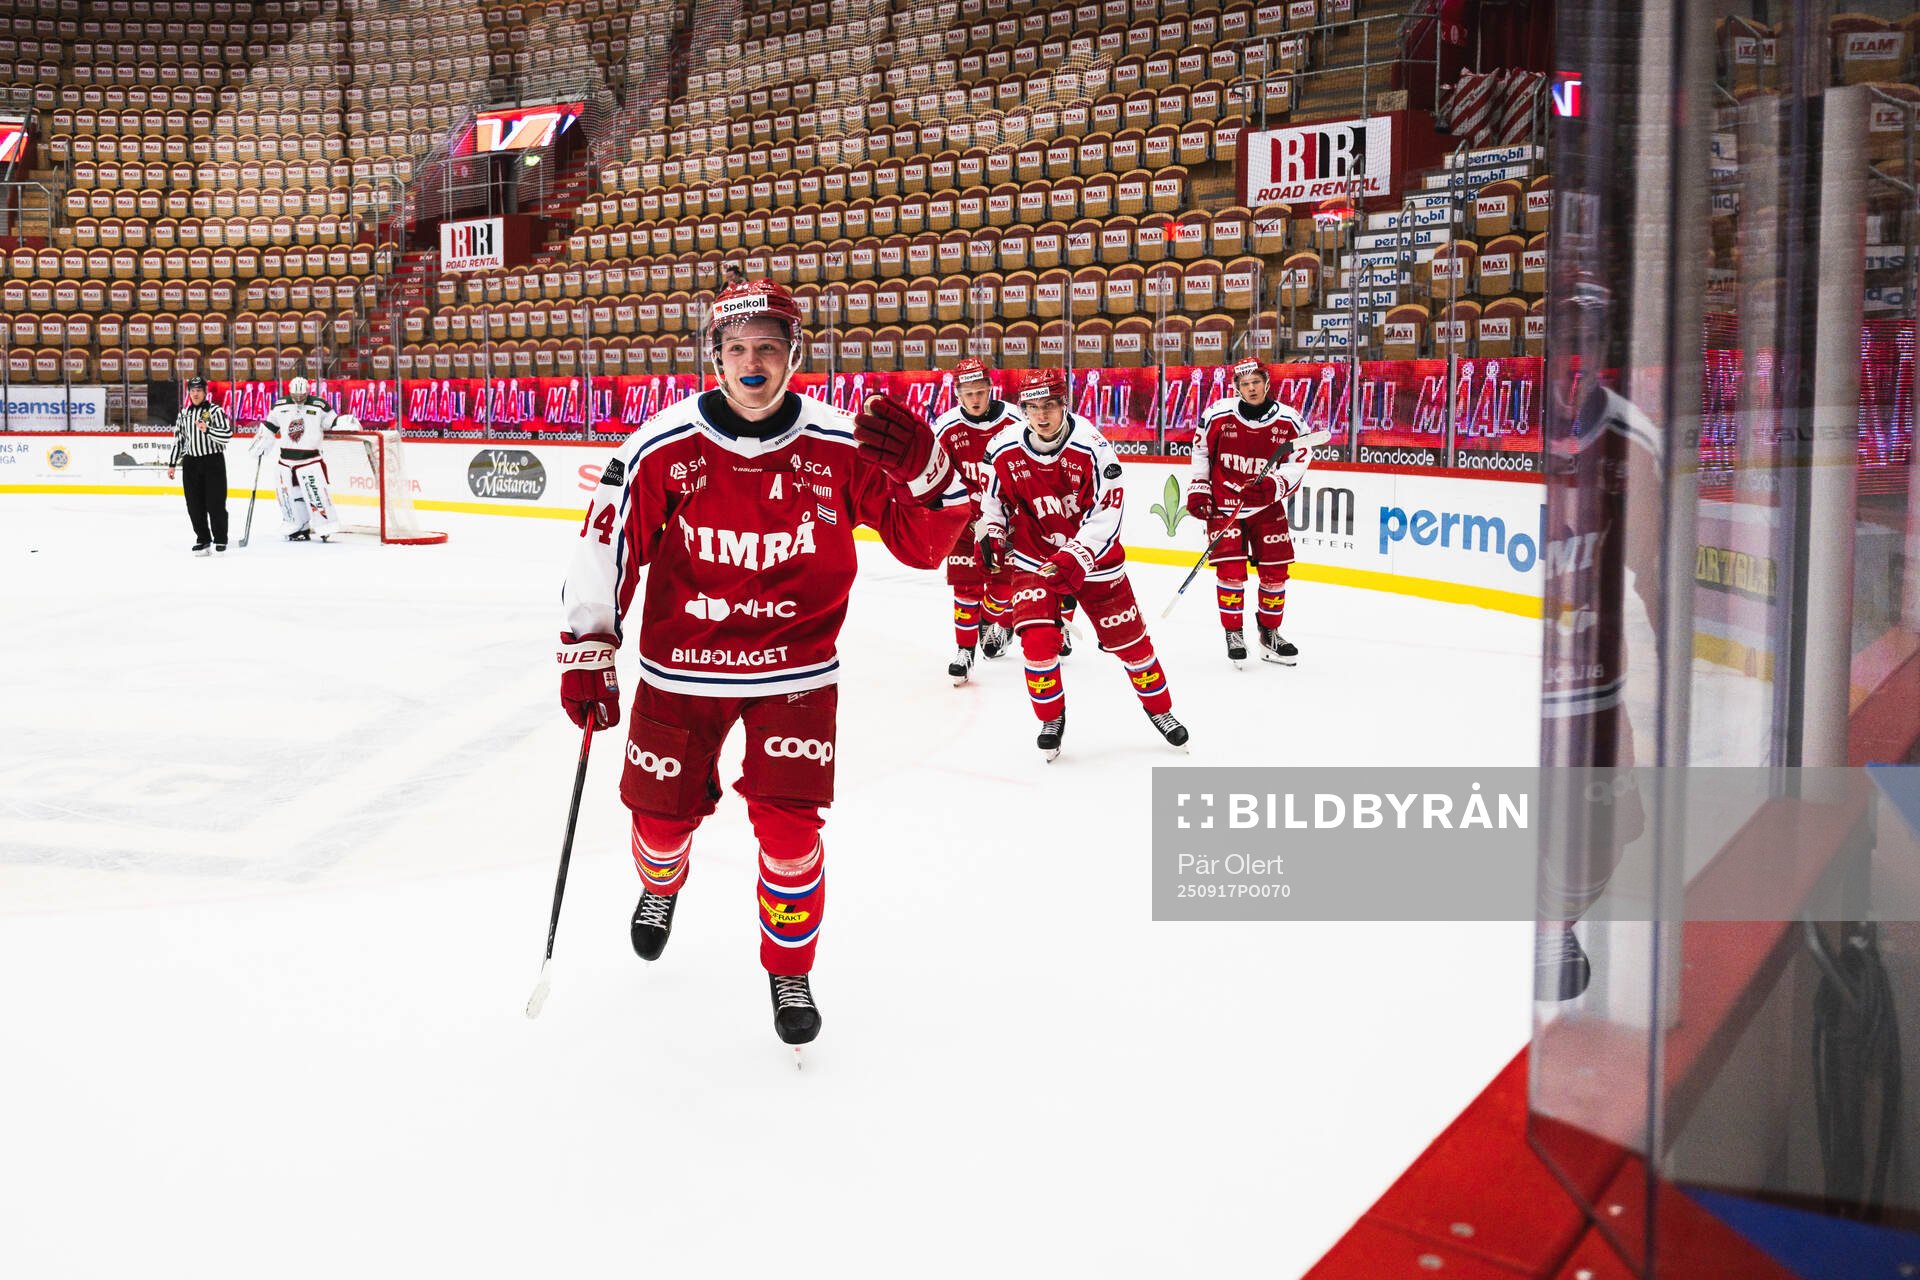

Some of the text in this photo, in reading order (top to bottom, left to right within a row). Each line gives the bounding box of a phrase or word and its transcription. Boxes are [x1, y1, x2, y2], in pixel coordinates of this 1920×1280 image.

[1259, 11, 1279, 19] MAXI
[1292, 5, 1315, 15] MAXI
[1194, 23, 1212, 33] MAXI
[1180, 59, 1199, 68] MAXI
[1118, 69, 1135, 78] MAXI
[1160, 101, 1180, 109] MAXI
[1183, 137, 1203, 145] MAXI
[1447, 169, 1506, 186] pemobil
[1121, 187, 1141, 195] MAXI
[1256, 177, 1380, 201] ROAD RENTAL
[1022, 196, 1041, 205] MAXI
[1053, 193, 1072, 201] MAXI
[1215, 226, 1239, 235] MAXI
[1036, 240, 1055, 248] MAXI
[1105, 235, 1127, 243] MAXI
[1374, 231, 1431, 248] permbil
[941, 247, 958, 256] MAXI
[446, 257, 499, 270] ROAD RENTAL
[1525, 257, 1546, 268] MAX
[1110, 284, 1132, 293] MAXI
[1187, 280, 1211, 289] MAXI
[722, 297, 766, 314] Spelkoll
[1005, 342, 1026, 350] MAXI
[1078, 340, 1100, 348] MAXI
[1115, 339, 1139, 347] MAXI
[1195, 336, 1220, 345] MAXI
[938, 344, 958, 352] MAXI
[1360, 446, 1435, 466] Brandcode
[1458, 451, 1533, 471] Brandcode
[486, 450, 520, 477] Yrkes
[1220, 453, 1277, 476] TIMR
[804, 461, 833, 478] SCA
[476, 474, 541, 497] Mästaren
[768, 473, 783, 500] A
[1033, 494, 1082, 520] IMR
[678, 511, 817, 571] TIMRÅ
[1378, 503, 1547, 573] permo
[1012, 587, 1047, 606] oop
[732, 598, 797, 619] NHC
[1099, 604, 1138, 629] coop
[671, 646, 788, 667] BILBOLAGET
[763, 735, 833, 767] coop
[627, 739, 682, 781] coop
